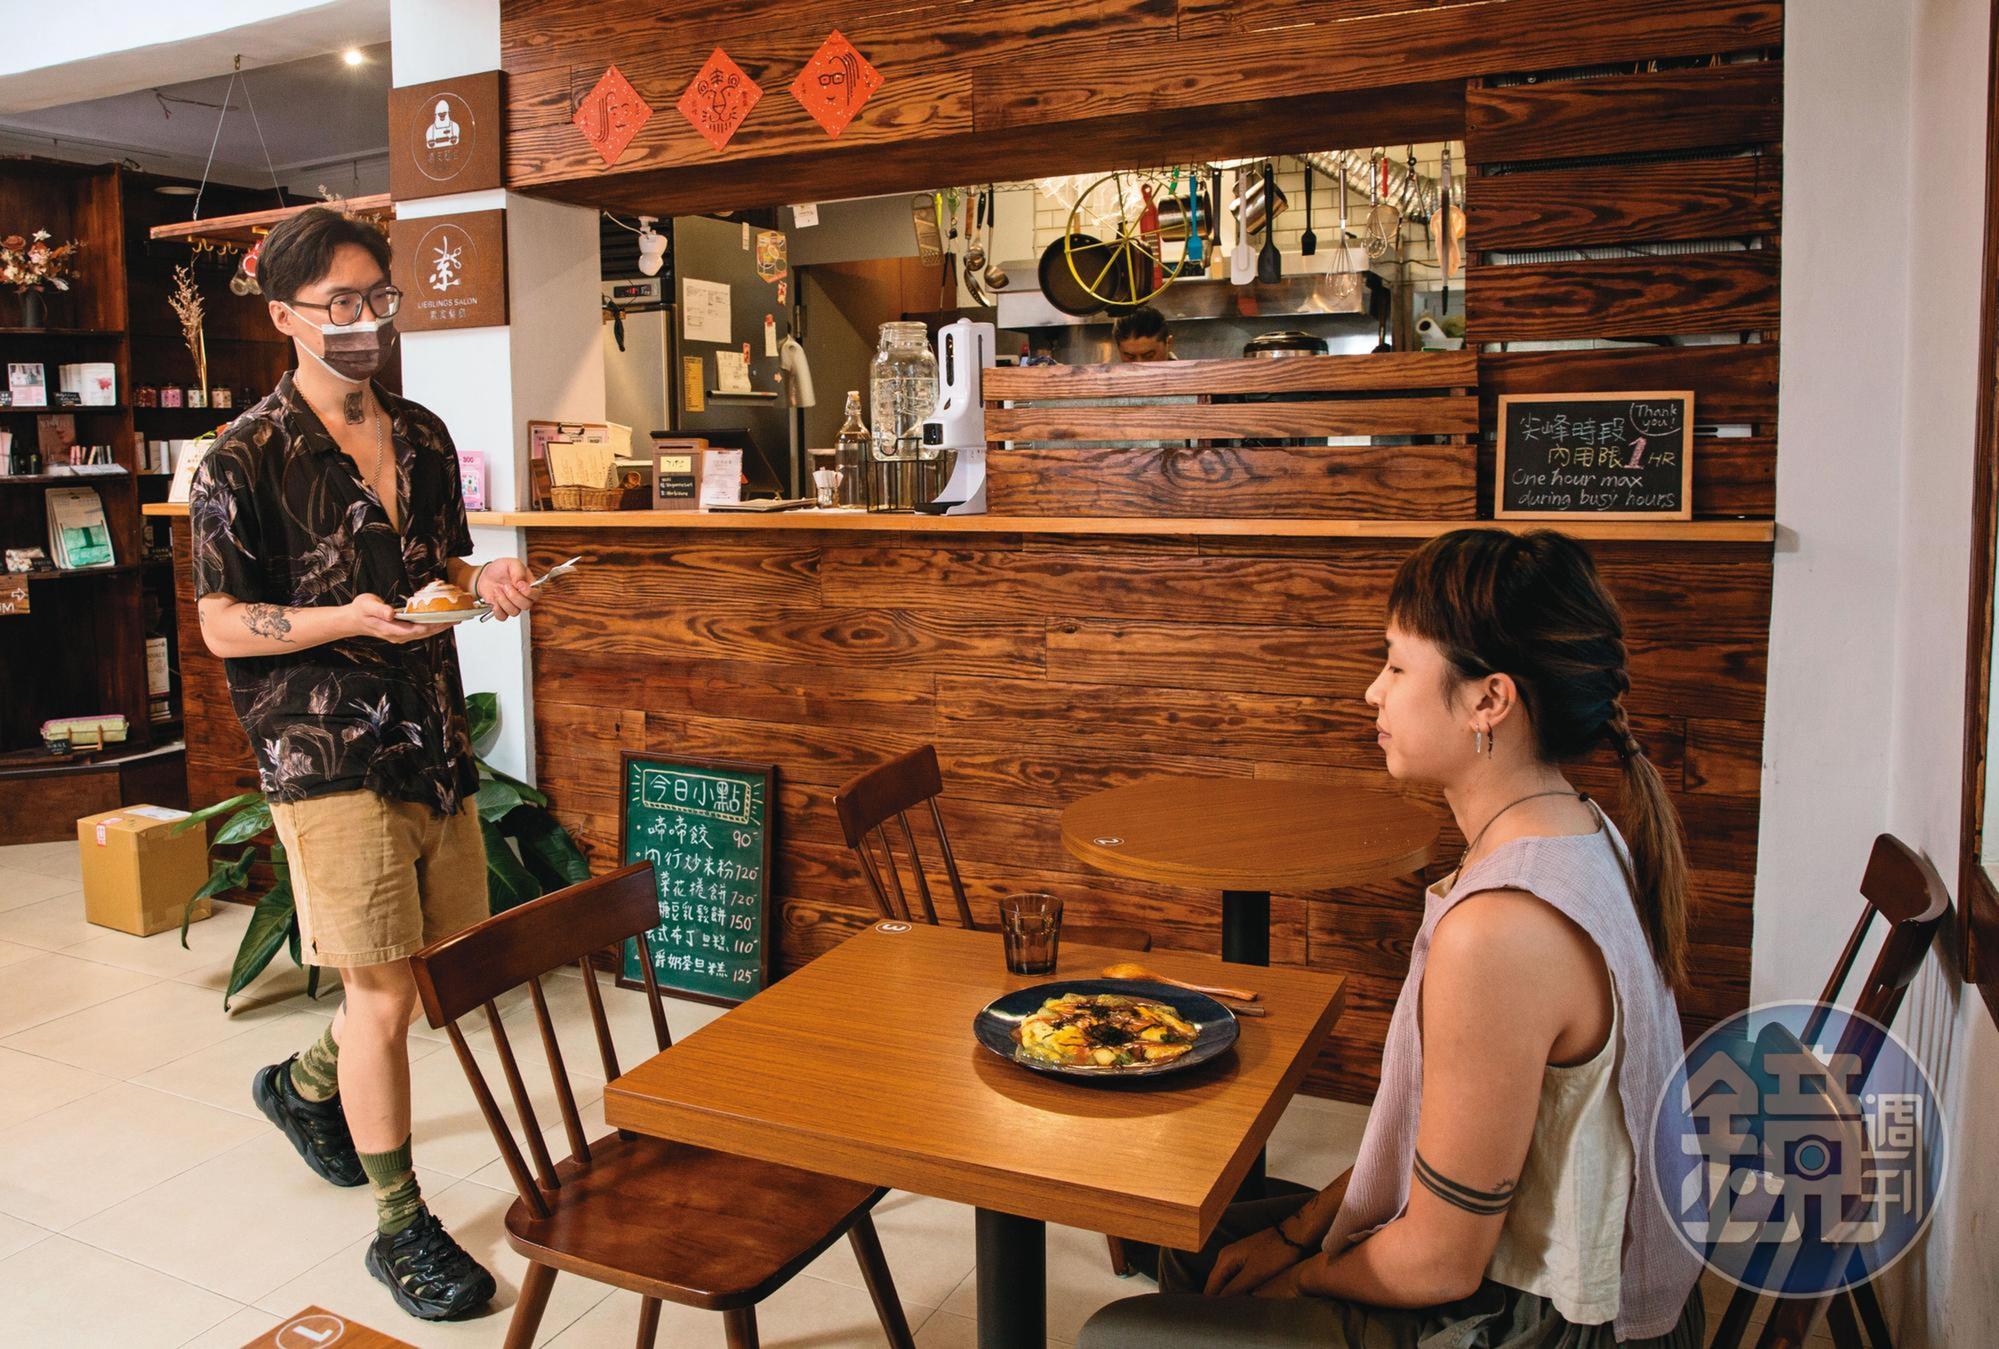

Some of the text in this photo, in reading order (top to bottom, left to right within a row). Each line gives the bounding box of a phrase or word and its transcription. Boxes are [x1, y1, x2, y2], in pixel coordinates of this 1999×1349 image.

[417, 297, 478, 309] LIEBLINGS SALON
[1637, 403, 1678, 418] Thank
[1520, 412, 1627, 445] 尖峰時段
[1643, 417, 1676, 433] you!
[1648, 452, 1676, 468] HR
[1512, 467, 1644, 488] One hour max
[1519, 489, 1676, 511] during busy hours
[650, 774, 740, 812] 今日小點
